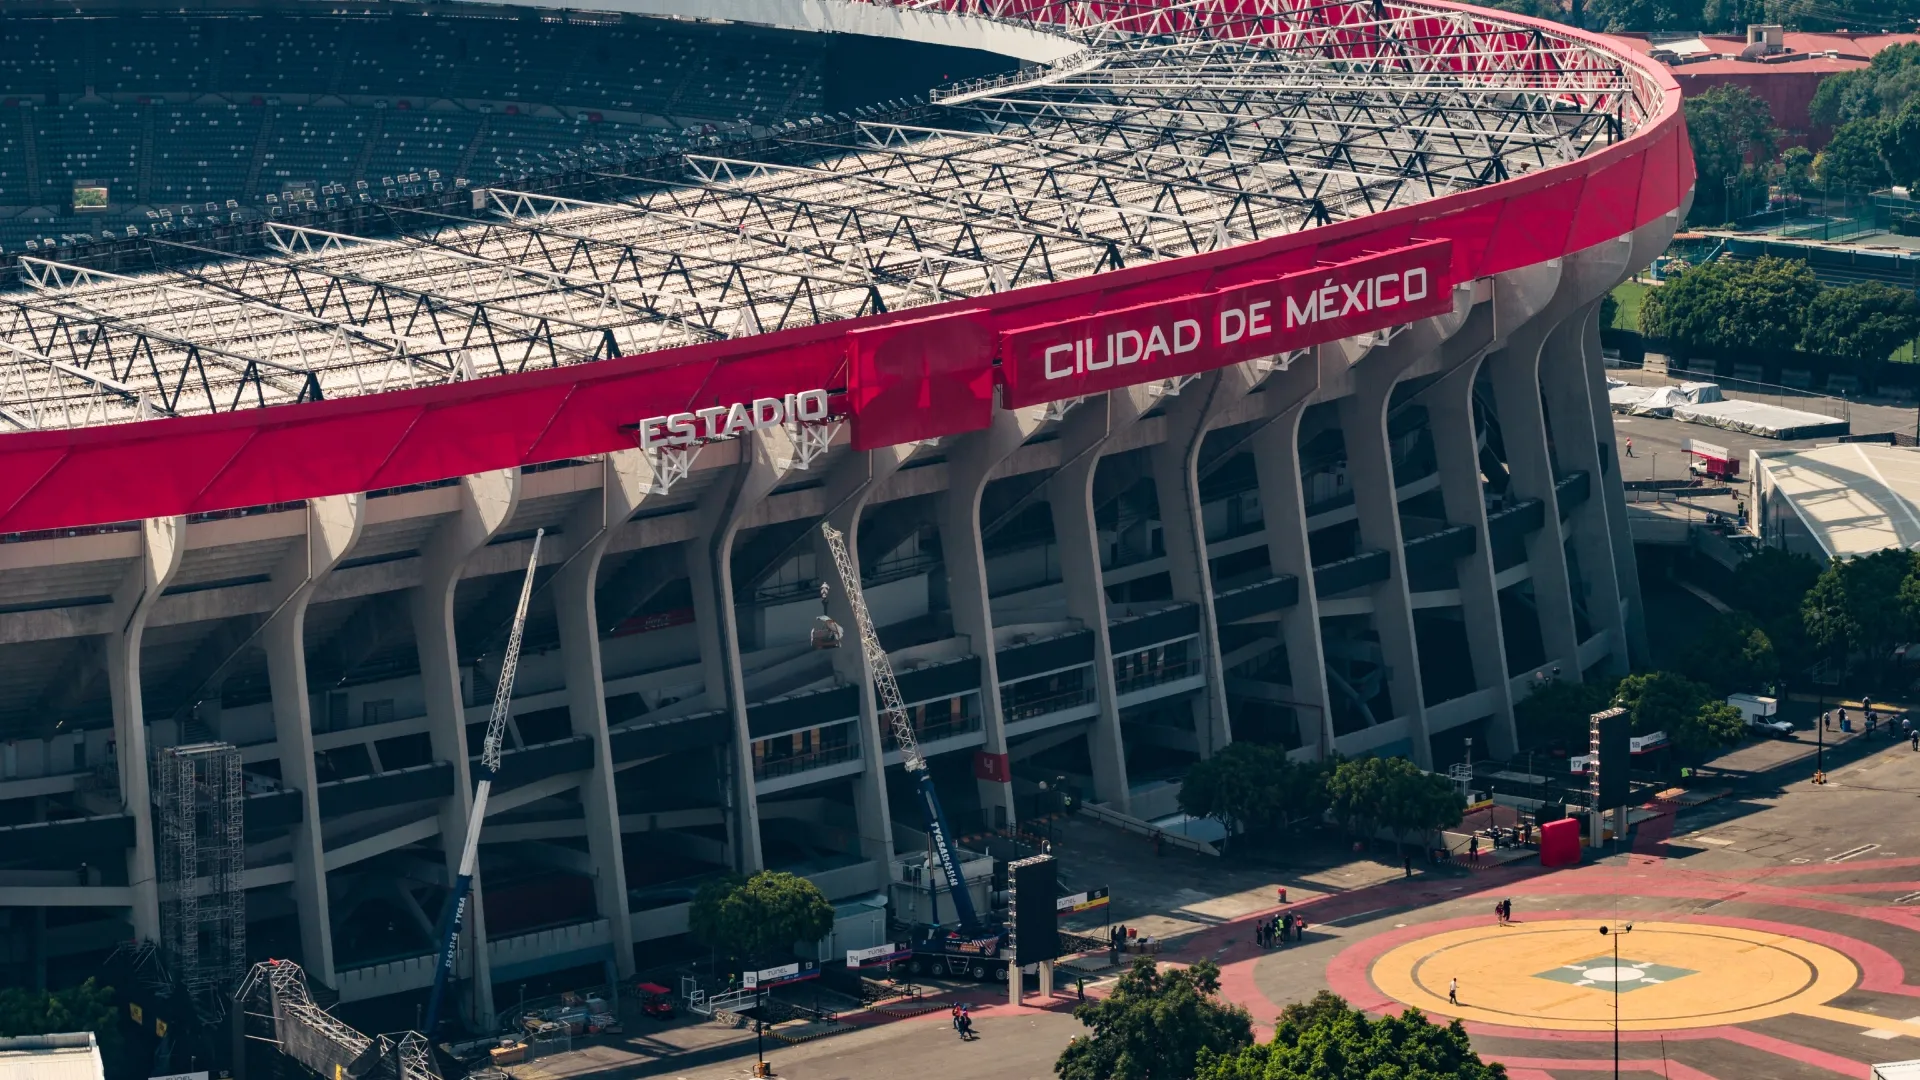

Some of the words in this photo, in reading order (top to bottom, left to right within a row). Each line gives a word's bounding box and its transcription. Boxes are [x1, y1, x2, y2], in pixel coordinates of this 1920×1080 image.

[1044, 318, 1202, 380] CIUDAD
[1220, 300, 1272, 345] DE
[1286, 266, 1428, 329] MÉXICO
[640, 389, 828, 449] ESTADIO
[983, 757, 994, 774] 4
[1572, 760, 1582, 768] 17
[930, 821, 948, 855] TYGSA
[454, 897, 467, 924] TYGSA
[745, 976, 756, 984] 13
[806, 962, 813, 970] 13
